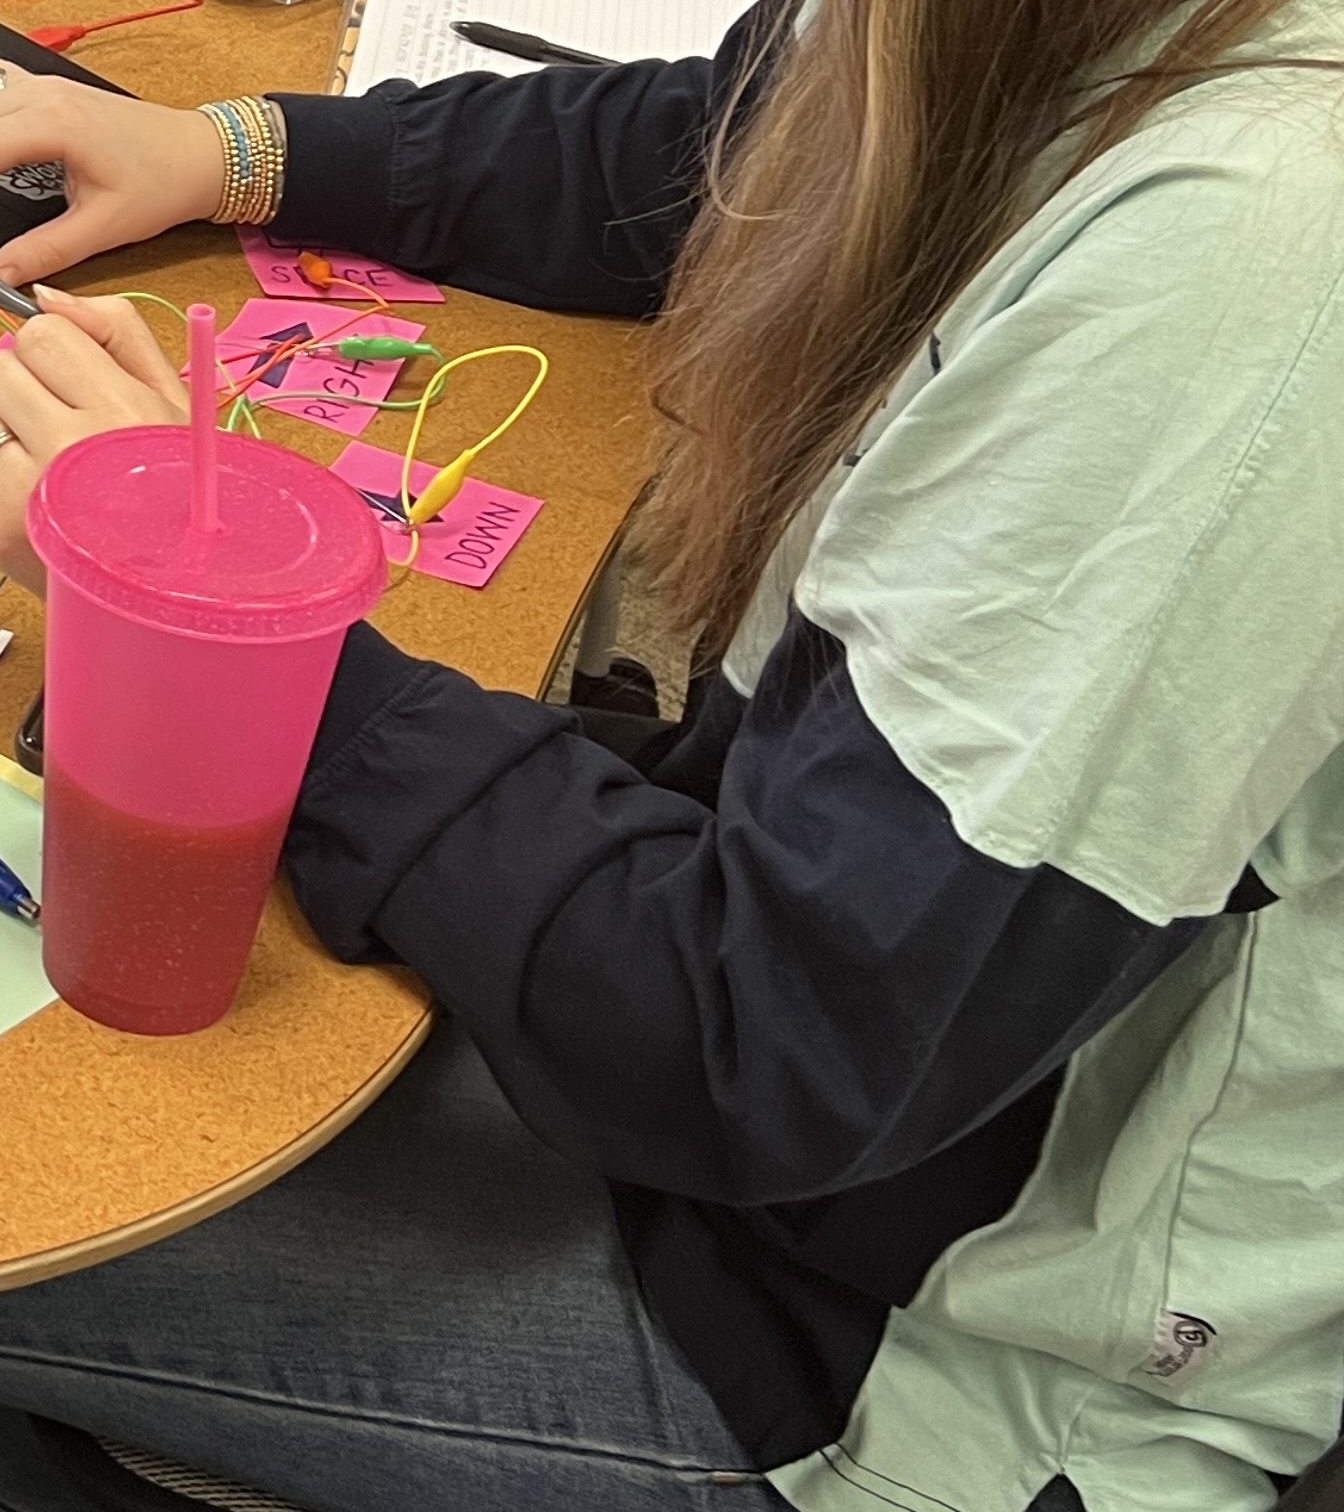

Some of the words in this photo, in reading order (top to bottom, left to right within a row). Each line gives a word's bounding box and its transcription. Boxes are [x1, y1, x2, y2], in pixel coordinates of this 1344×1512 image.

[270, 264, 395, 288] SCE
[304, 358, 376, 424] RIGH
[445, 501, 521, 570] DOWN
